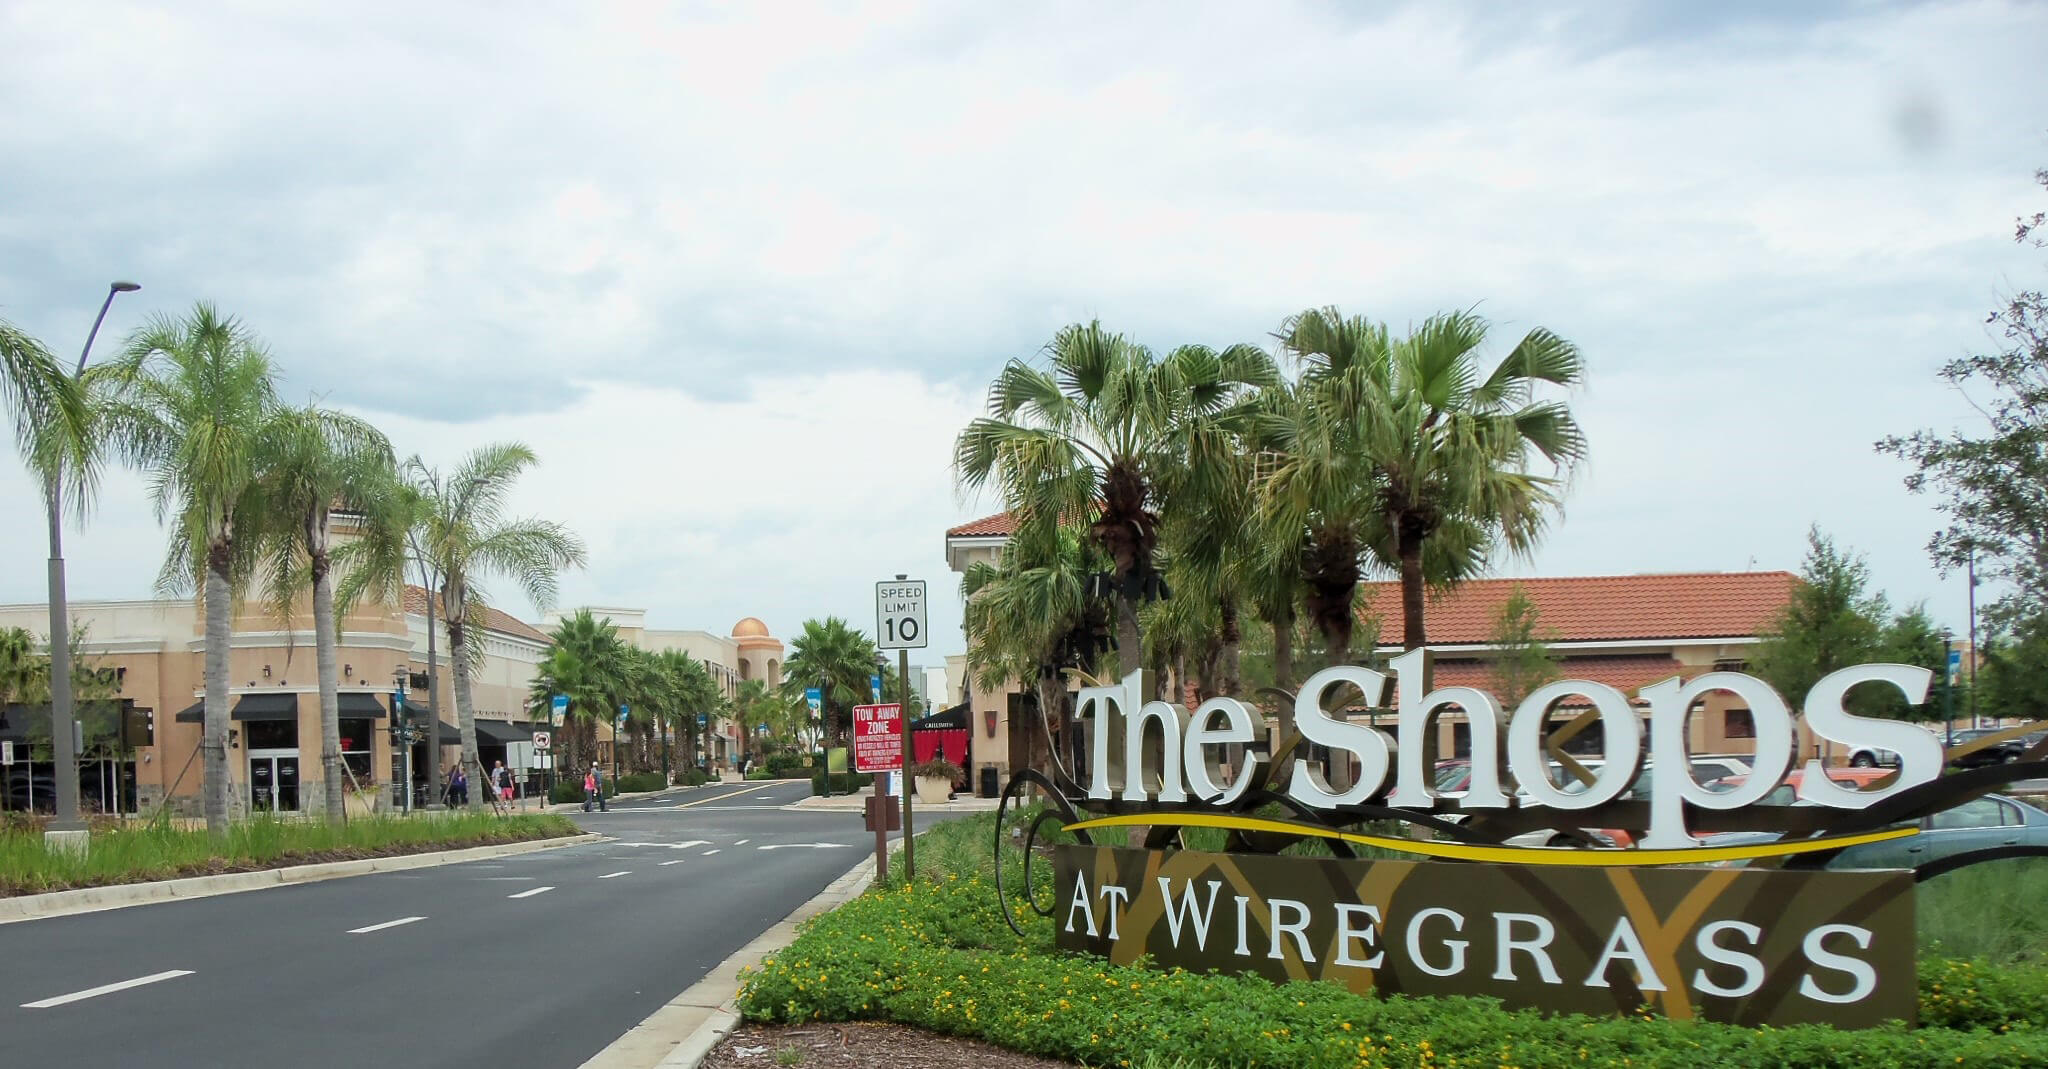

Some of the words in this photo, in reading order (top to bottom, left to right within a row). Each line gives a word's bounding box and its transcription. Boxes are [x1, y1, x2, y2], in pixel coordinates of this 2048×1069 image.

[881, 588, 922, 599] SPEED
[885, 602, 918, 613] LIMIT
[885, 617, 919, 642] 10
[855, 708, 874, 721] TOW
[877, 706, 901, 720] AWAY
[867, 720, 890, 735] ZONE
[1075, 668, 1262, 806] The
[1288, 646, 1946, 850] Shops
[1156, 876, 1878, 1004] WIREGRASS
